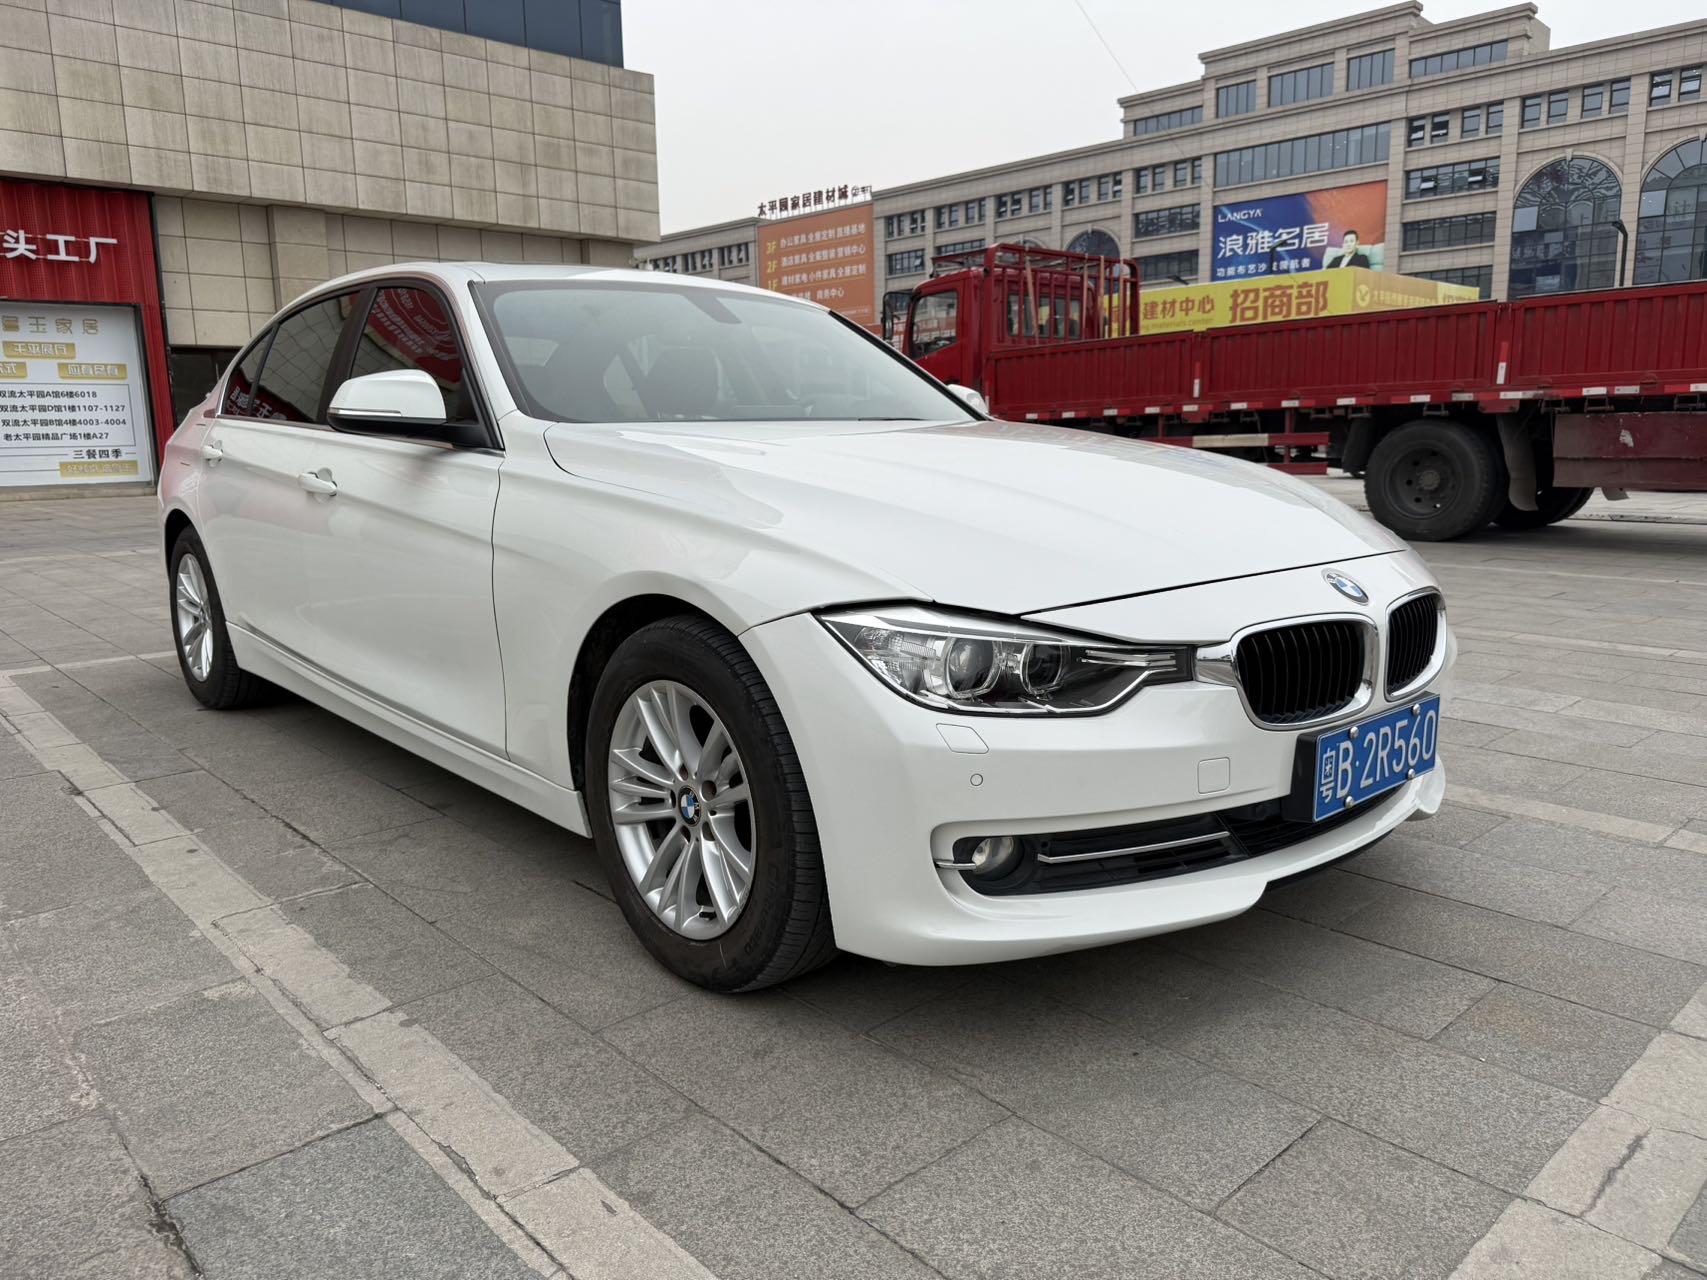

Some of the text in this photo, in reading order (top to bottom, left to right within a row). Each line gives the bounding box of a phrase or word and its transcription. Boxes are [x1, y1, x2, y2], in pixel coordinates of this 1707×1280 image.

[1218, 208, 1262, 222] LANGYA
[3, 229, 118, 264] 头工厂
[766, 241, 777, 255] 3F
[1217, 223, 1330, 259] 浪雅名居
[767, 260, 778, 273] 2F
[1142, 294, 1215, 320] 建材中心
[1229, 280, 1329, 324] 招商部
[1, 418, 127, 427] 双流太平园B馆4楼4003-4004
[3, 432, 109, 441] 老太平园精品广场1楼A27
[73, 448, 122, 459] 三餐四季
